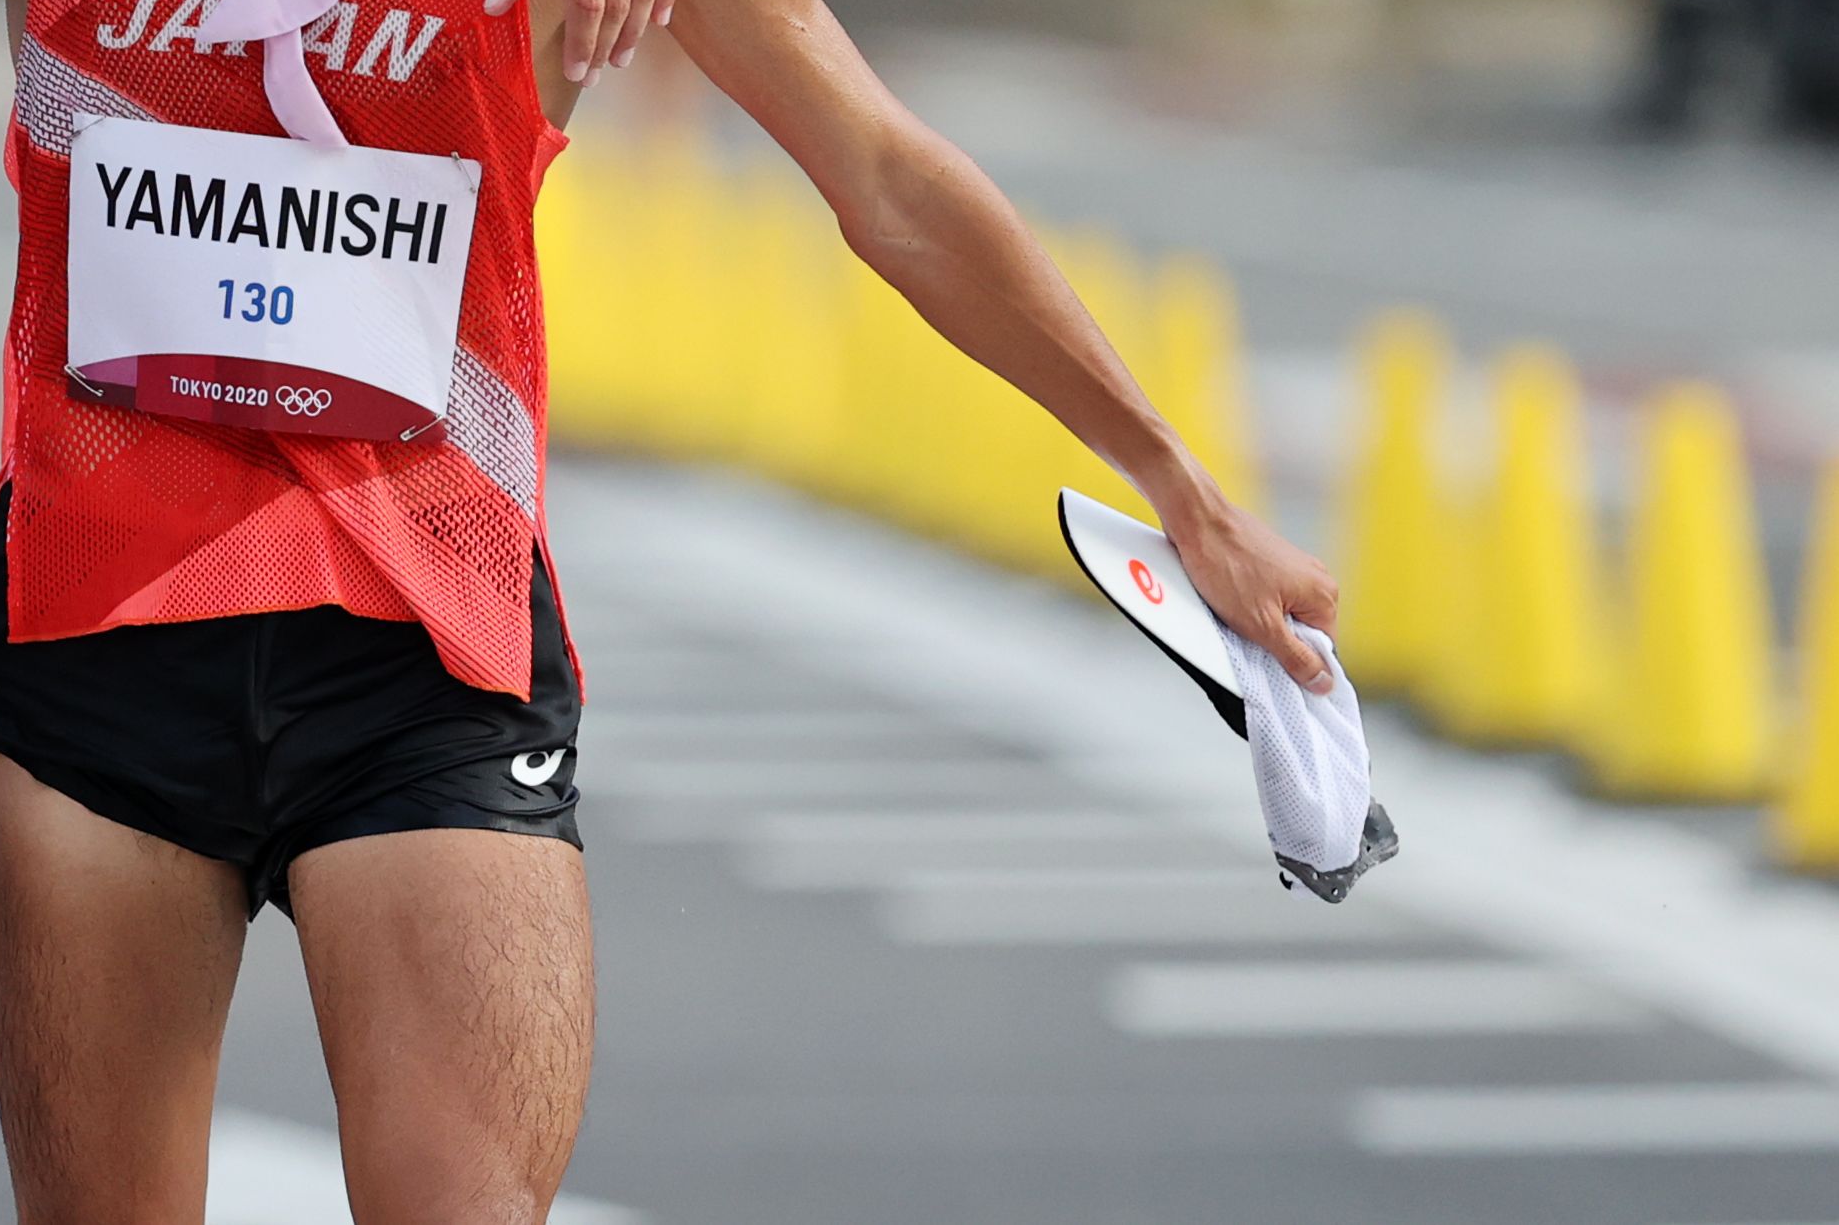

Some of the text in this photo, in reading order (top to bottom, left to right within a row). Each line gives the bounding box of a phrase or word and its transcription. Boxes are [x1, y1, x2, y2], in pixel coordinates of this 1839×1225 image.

[95, 162, 448, 264] YAMANISHI
[217, 279, 295, 326] 130
[169, 375, 269, 407] TOKYO 2020
